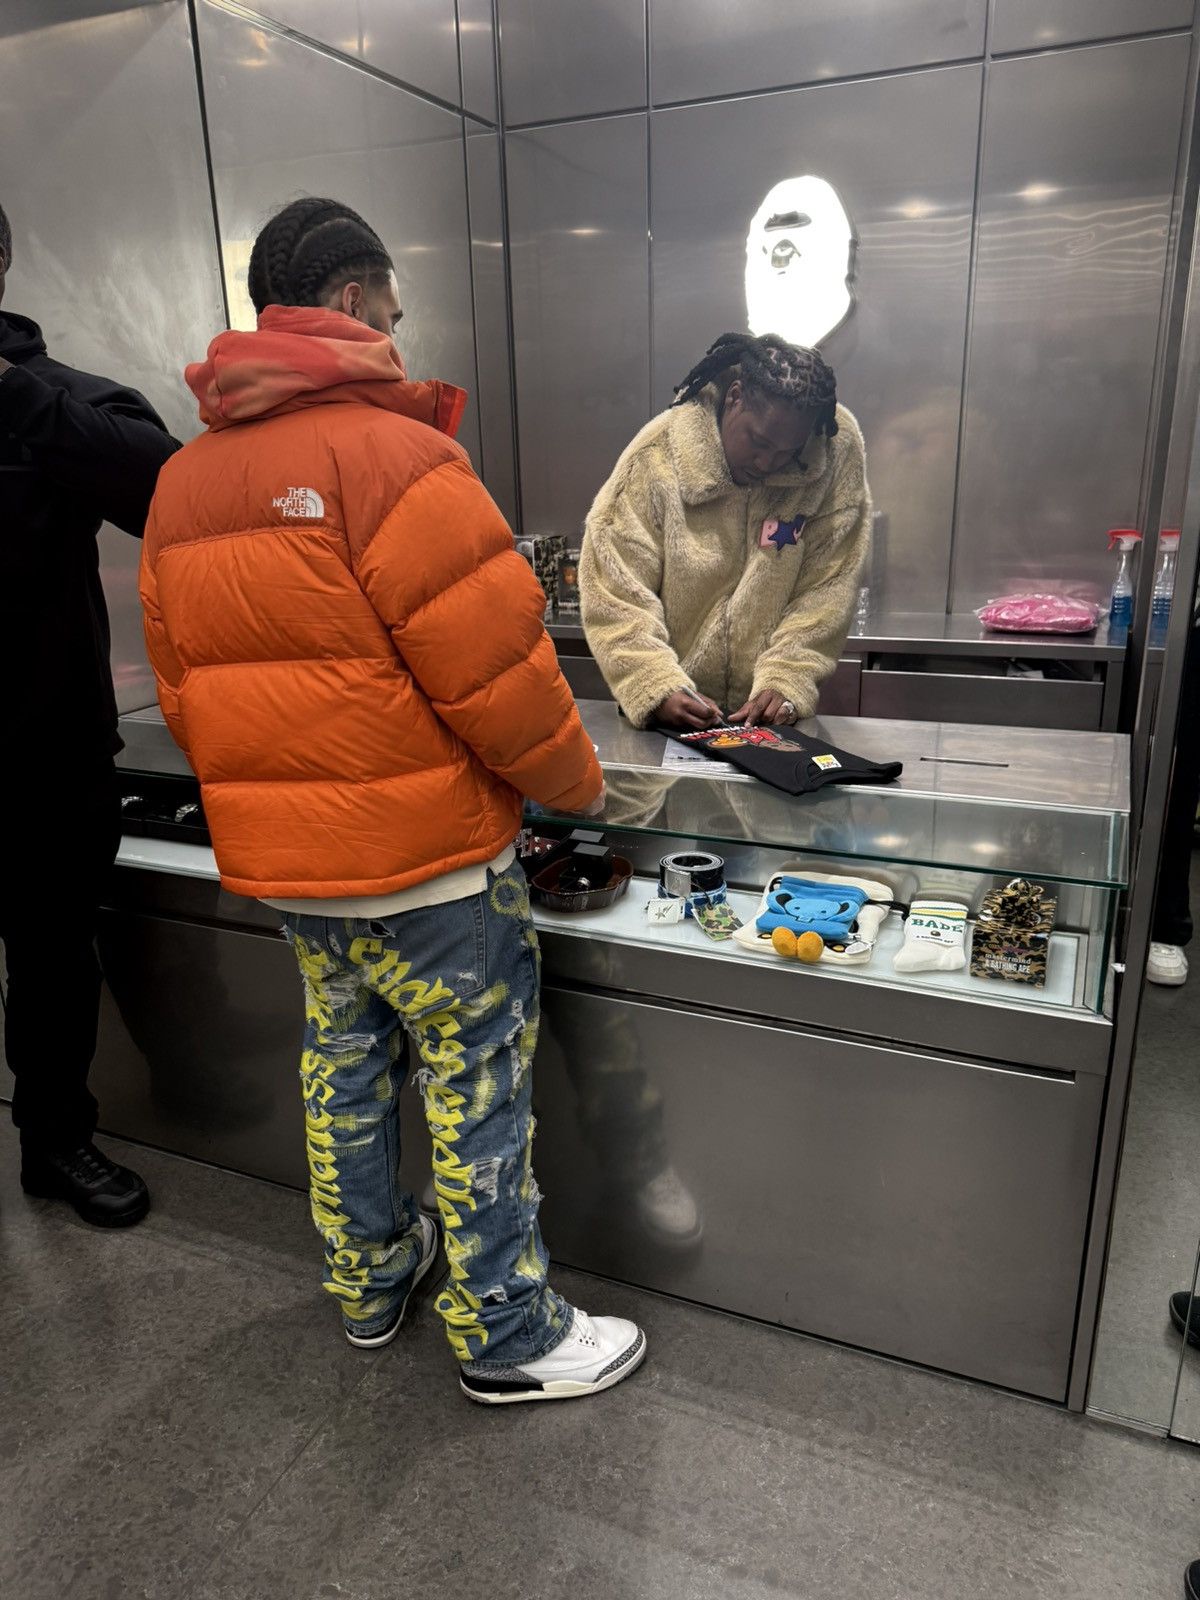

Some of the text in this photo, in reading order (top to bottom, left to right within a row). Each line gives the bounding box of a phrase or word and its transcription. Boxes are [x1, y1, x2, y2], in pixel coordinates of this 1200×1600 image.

[287, 487, 307, 498] THE
[272, 497, 306, 507] NORTH
[283, 507, 306, 517] FACE
